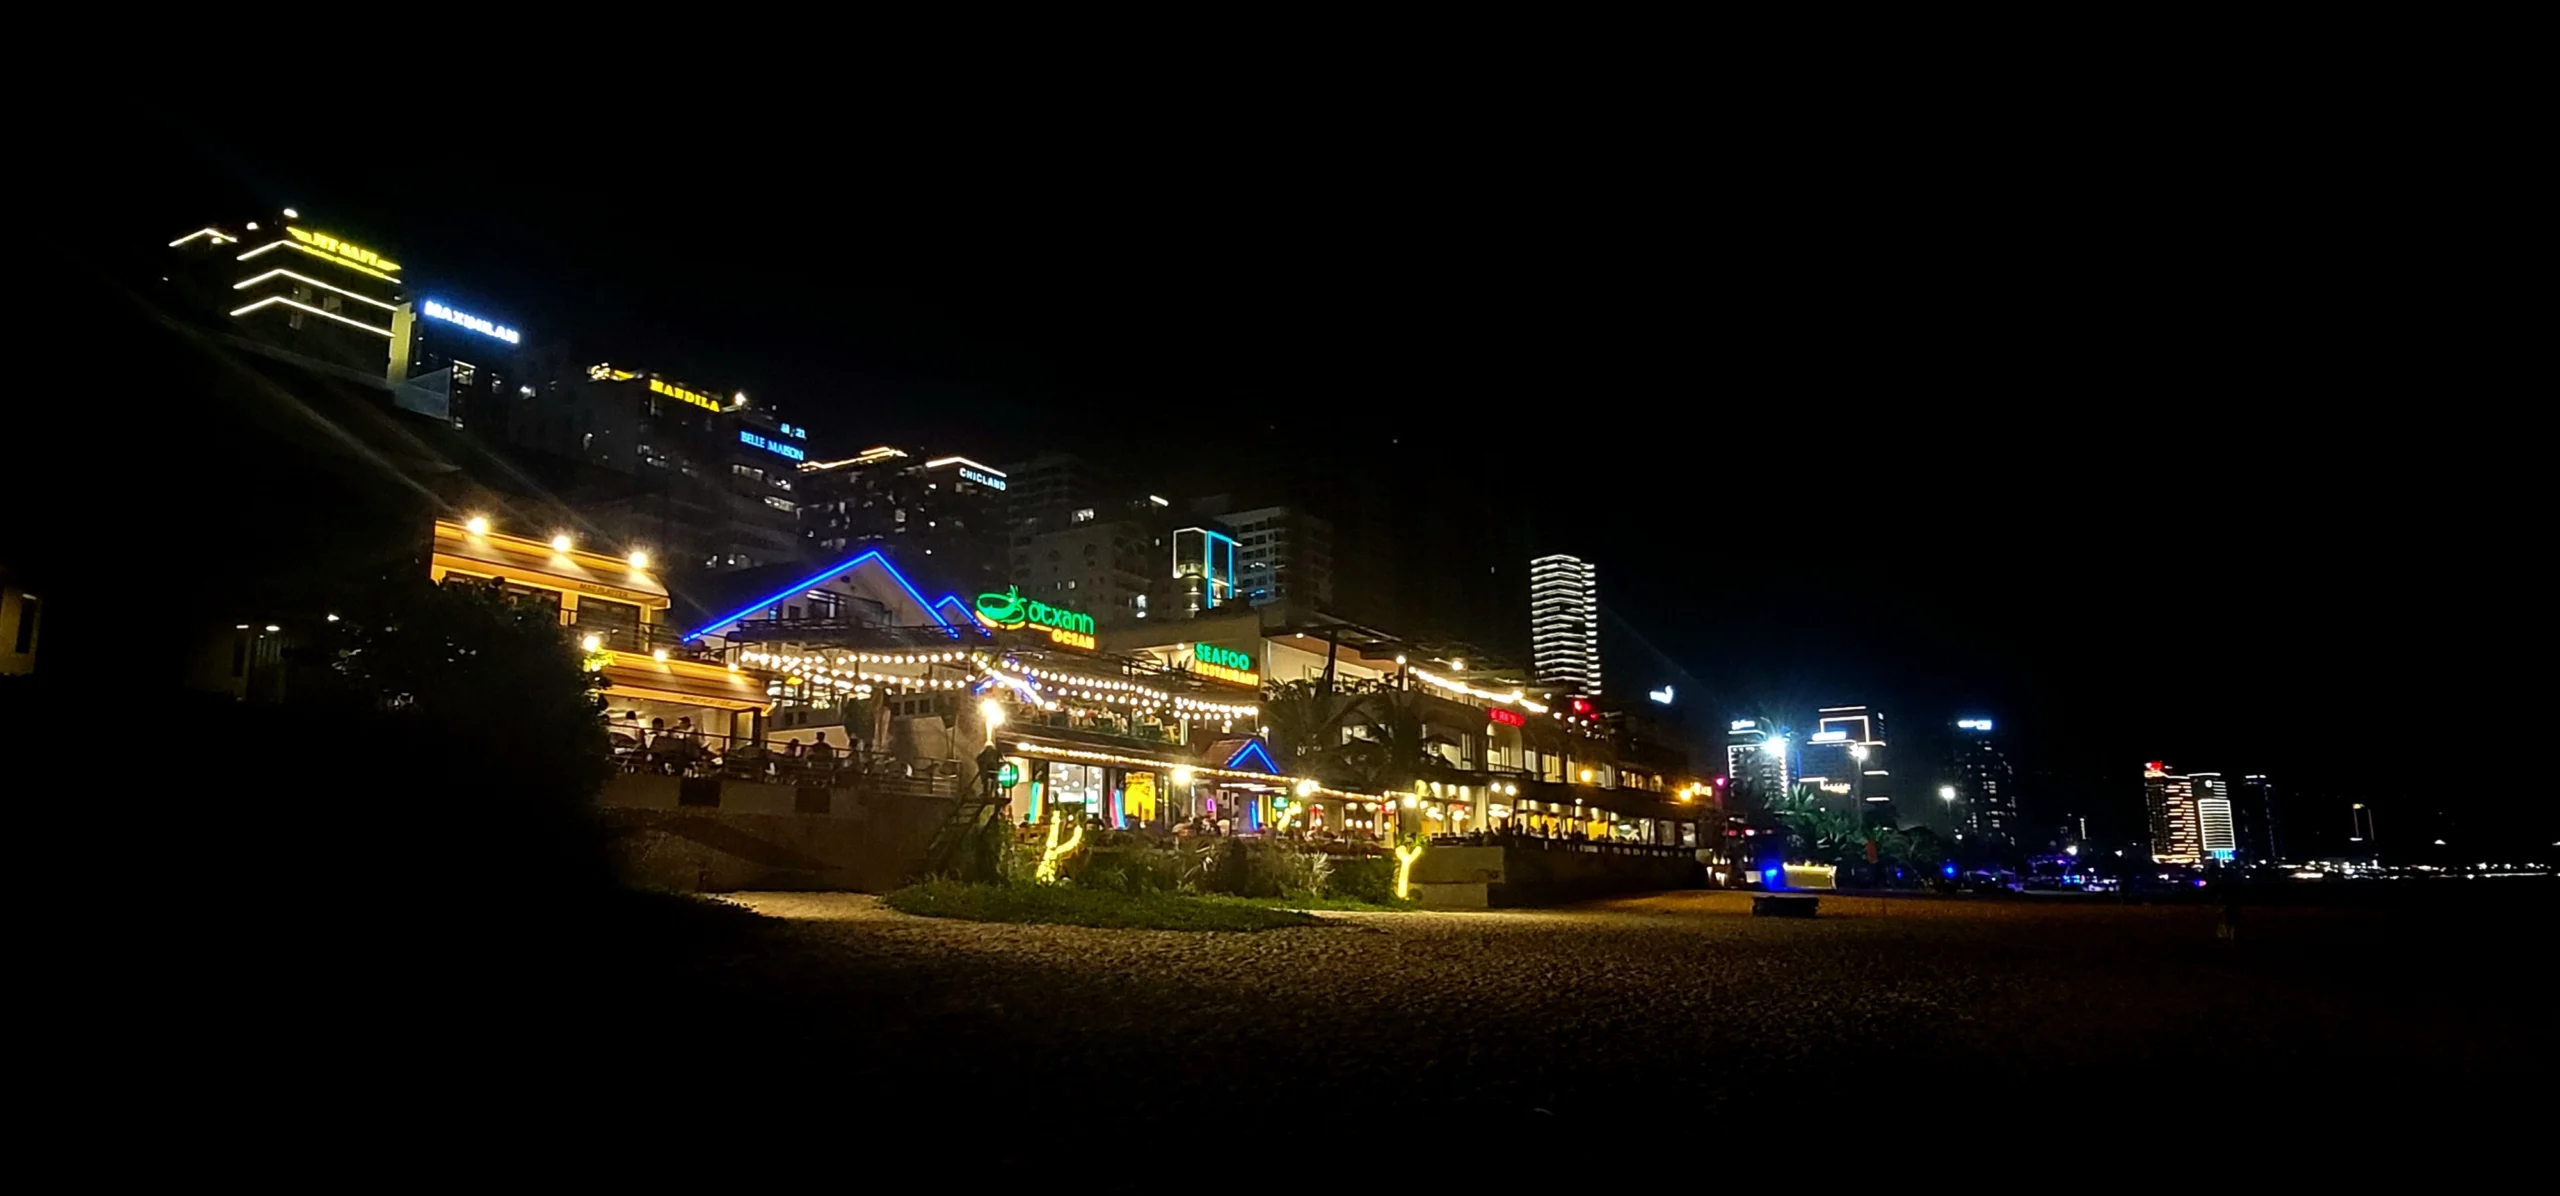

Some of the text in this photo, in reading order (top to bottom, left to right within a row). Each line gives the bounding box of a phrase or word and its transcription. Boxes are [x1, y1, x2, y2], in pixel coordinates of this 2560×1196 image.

[649, 378, 720, 413] MANDILA
[740, 430, 766, 449] BELLE
[767, 440, 804, 461] MAISON
[959, 467, 1007, 491] CHICLAND
[1051, 628, 1095, 650] OCEAN
[1195, 660, 1259, 687] RESTAURANT
